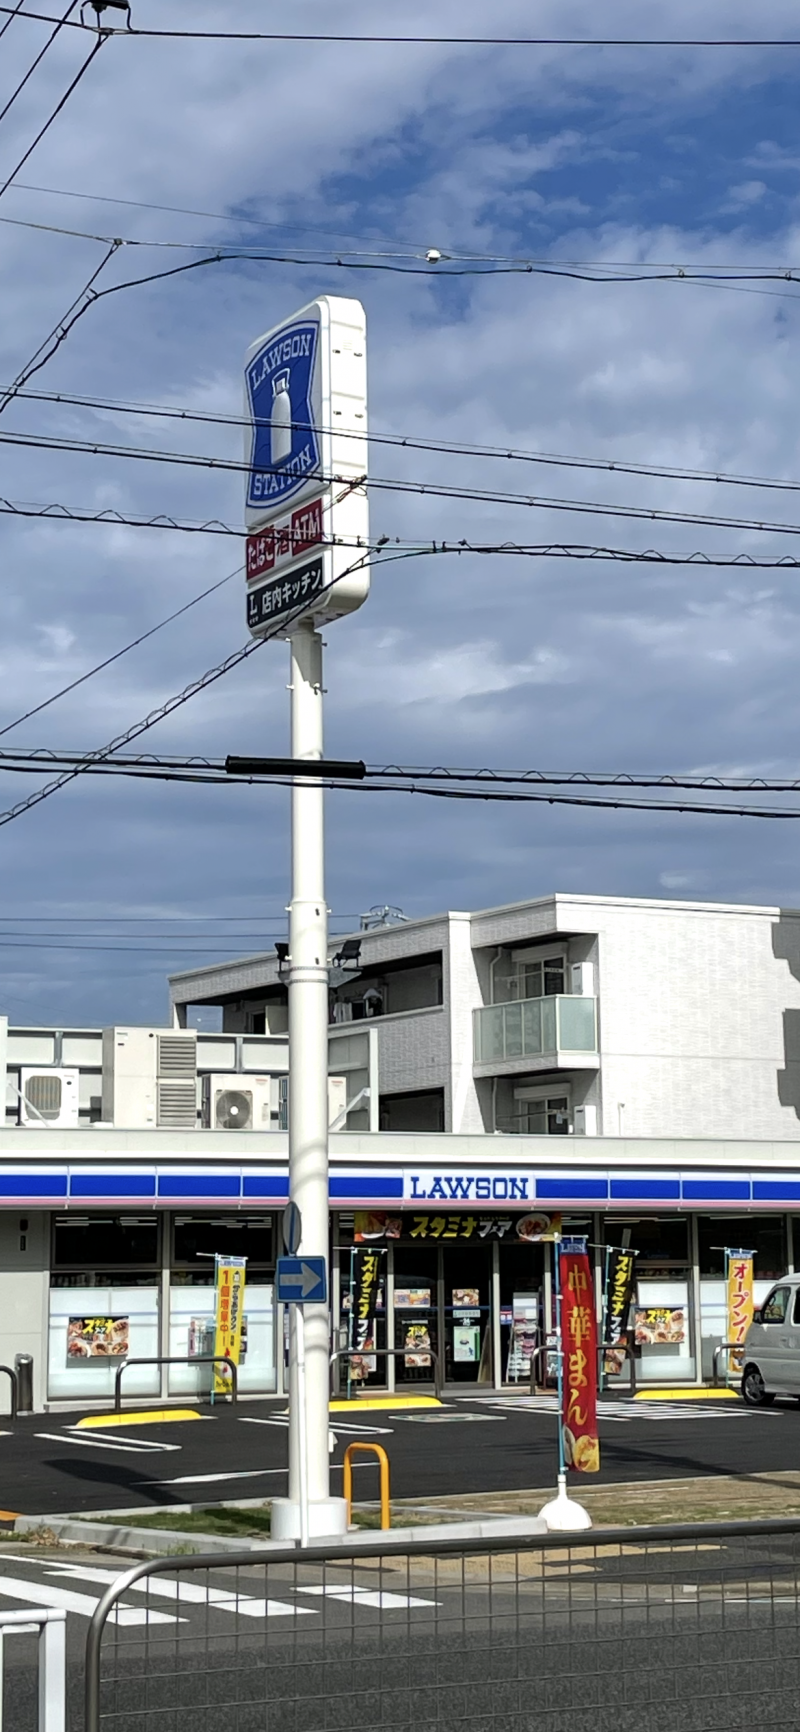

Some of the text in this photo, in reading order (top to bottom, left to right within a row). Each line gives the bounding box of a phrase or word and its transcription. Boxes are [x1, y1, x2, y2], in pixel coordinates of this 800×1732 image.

[251, 334, 311, 391] LAWSON
[253, 443, 312, 496] STATION
[293, 508, 320, 548] ATM
[262, 568, 321, 615] 店内キッチン
[410, 1176, 529, 1199] LAWSON
[409, 1216, 513, 1239] スタミナフェア
[567, 1264, 592, 1425] 中華まん
